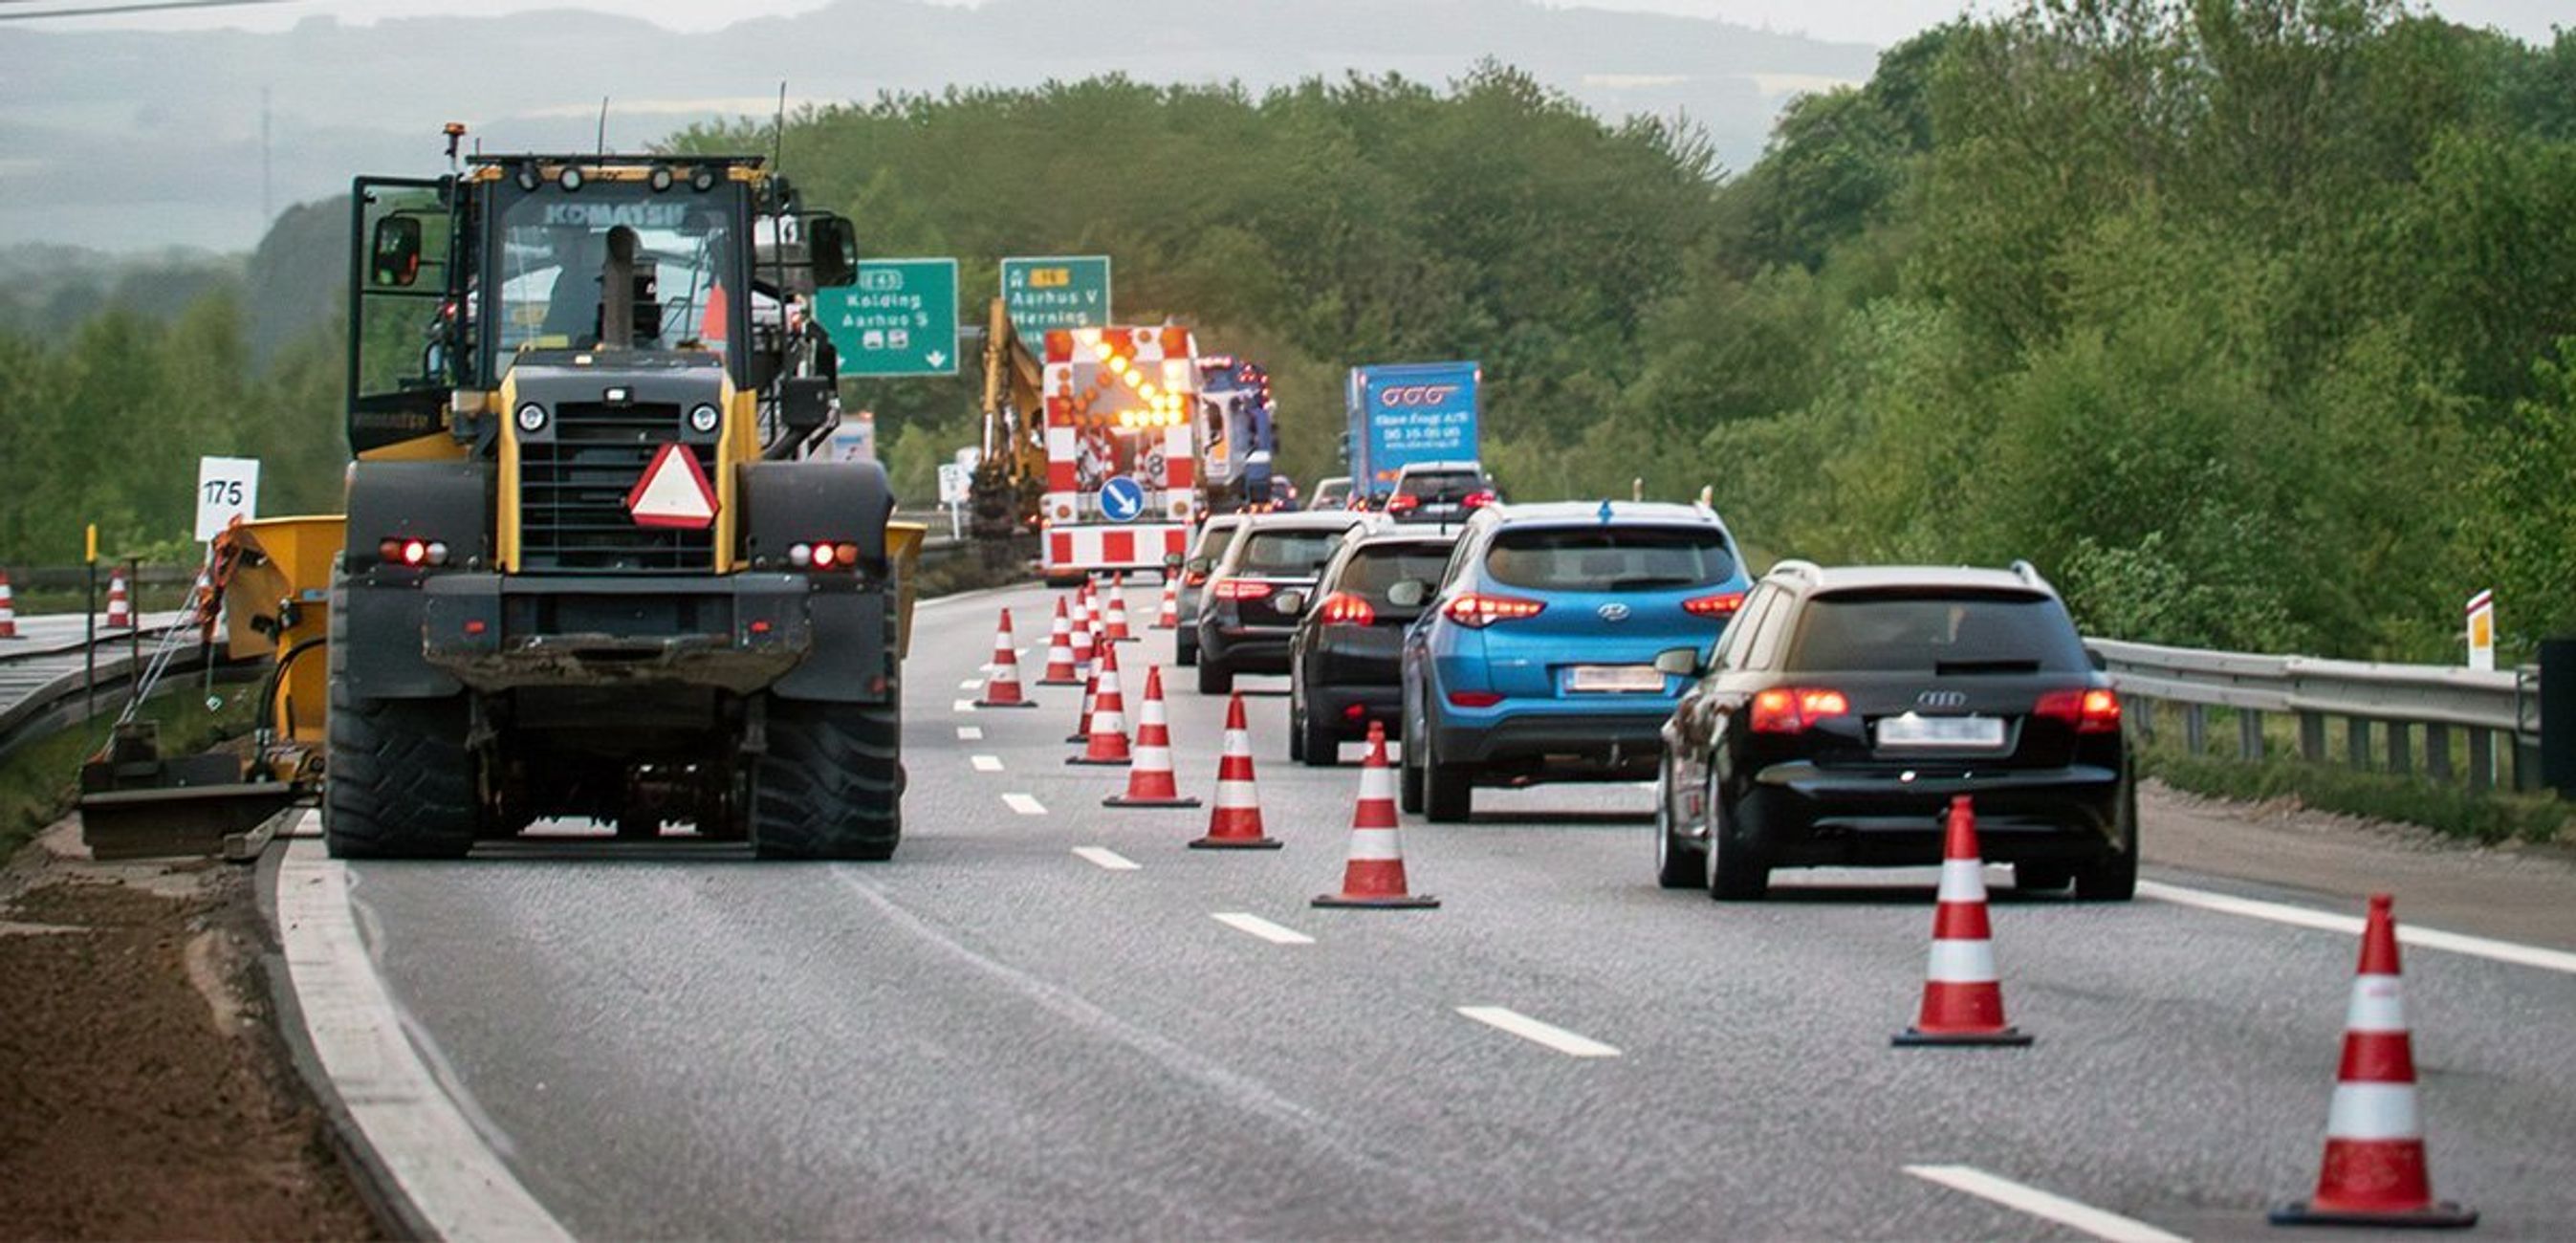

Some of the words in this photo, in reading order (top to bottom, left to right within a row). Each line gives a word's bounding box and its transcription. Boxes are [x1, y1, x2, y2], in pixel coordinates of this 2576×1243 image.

[546, 203, 687, 225] KOMATSU
[847, 294, 922, 311] Kolding
[1012, 291, 1080, 305] Aarhus
[1085, 290, 1098, 304] V
[842, 313, 909, 328] Aarhus
[915, 312, 928, 327] S
[1011, 312, 1088, 326] Herning
[204, 480, 244, 506] 175
